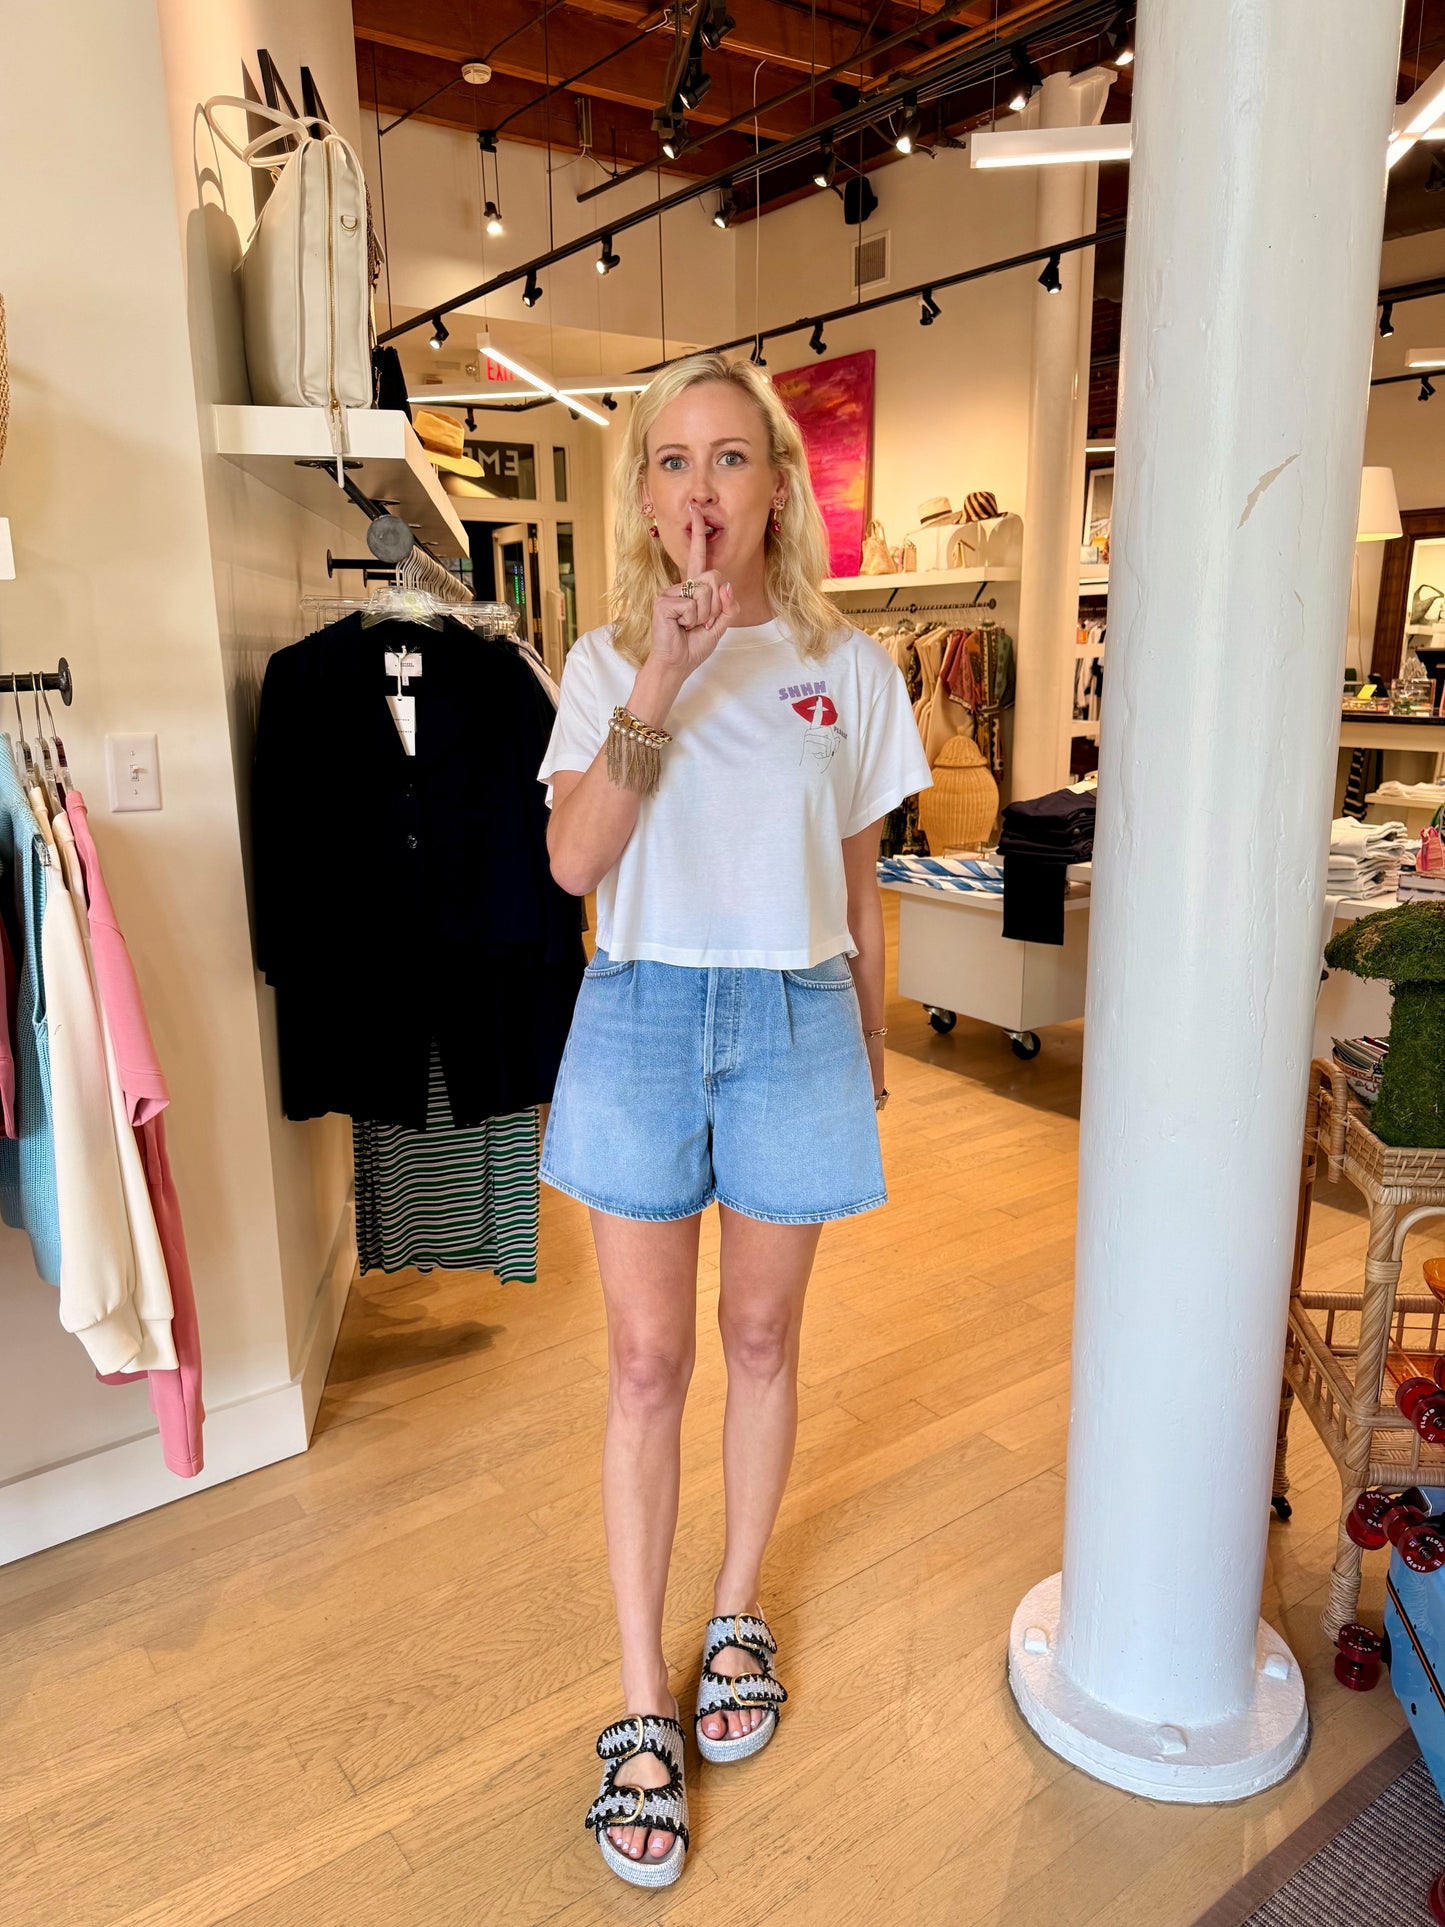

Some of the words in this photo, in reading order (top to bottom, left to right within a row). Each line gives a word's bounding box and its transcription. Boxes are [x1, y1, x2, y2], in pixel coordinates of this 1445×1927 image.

[778, 681, 826, 701] SHHH
[1420, 1408, 1436, 1429] FLOYD
[1366, 1493, 1390, 1504] FLOYD
[1367, 1518, 1383, 1528] OYD
[1425, 1536, 1445, 1553] FLOYD
[1406, 1555, 1426, 1571] FLOYD
[1351, 1625, 1375, 1636] FLOYD
